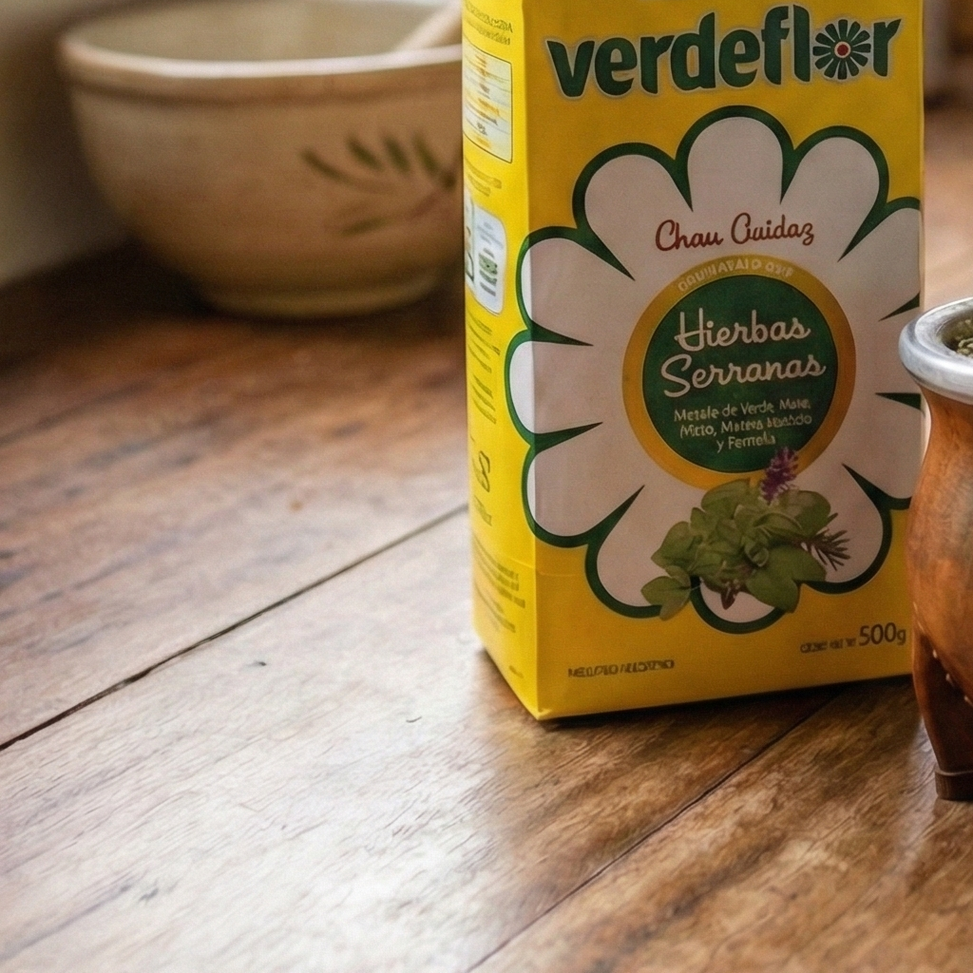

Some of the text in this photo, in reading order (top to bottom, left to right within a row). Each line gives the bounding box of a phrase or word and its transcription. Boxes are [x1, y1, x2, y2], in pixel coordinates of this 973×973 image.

[546, 3, 902, 98] verdeflor
[655, 219, 724, 252] Chau
[674, 307, 811, 352] Hierbas
[660, 353, 827, 398] Serranas
[721, 403, 738, 417] de
[859, 622, 906, 646] 500g
